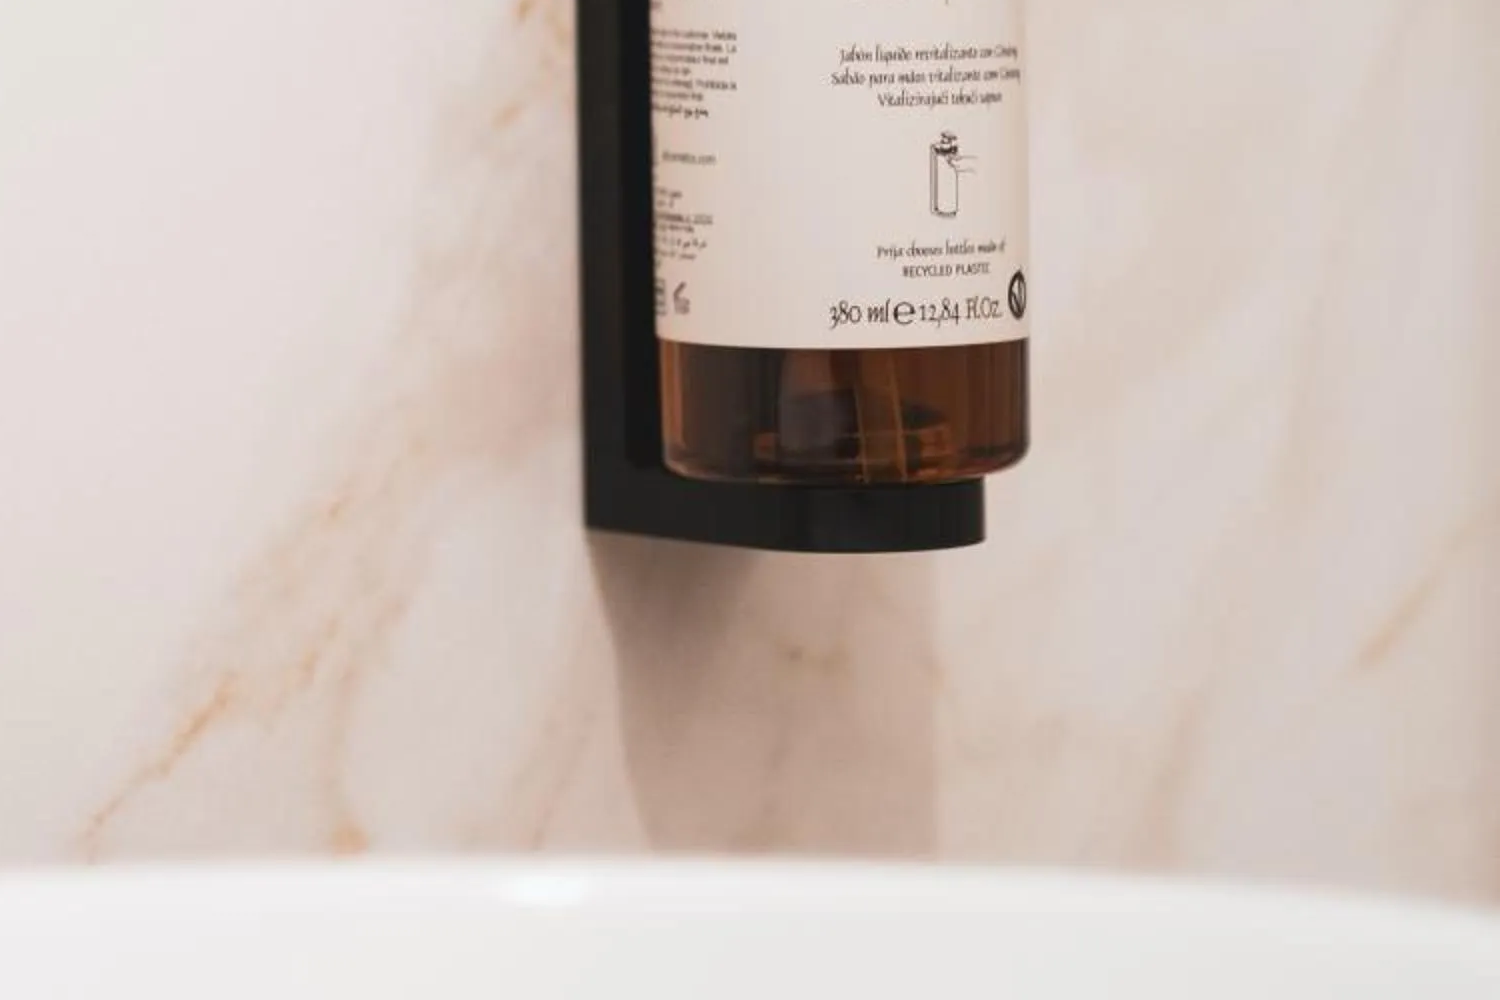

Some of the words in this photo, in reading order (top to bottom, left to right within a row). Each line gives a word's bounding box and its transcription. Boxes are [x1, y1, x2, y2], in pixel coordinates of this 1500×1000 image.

[903, 264, 952, 278] RECYCLED
[955, 262, 990, 275] PLASTIC
[829, 301, 862, 329] 380
[867, 298, 890, 323] ml
[920, 298, 960, 327] 12,84
